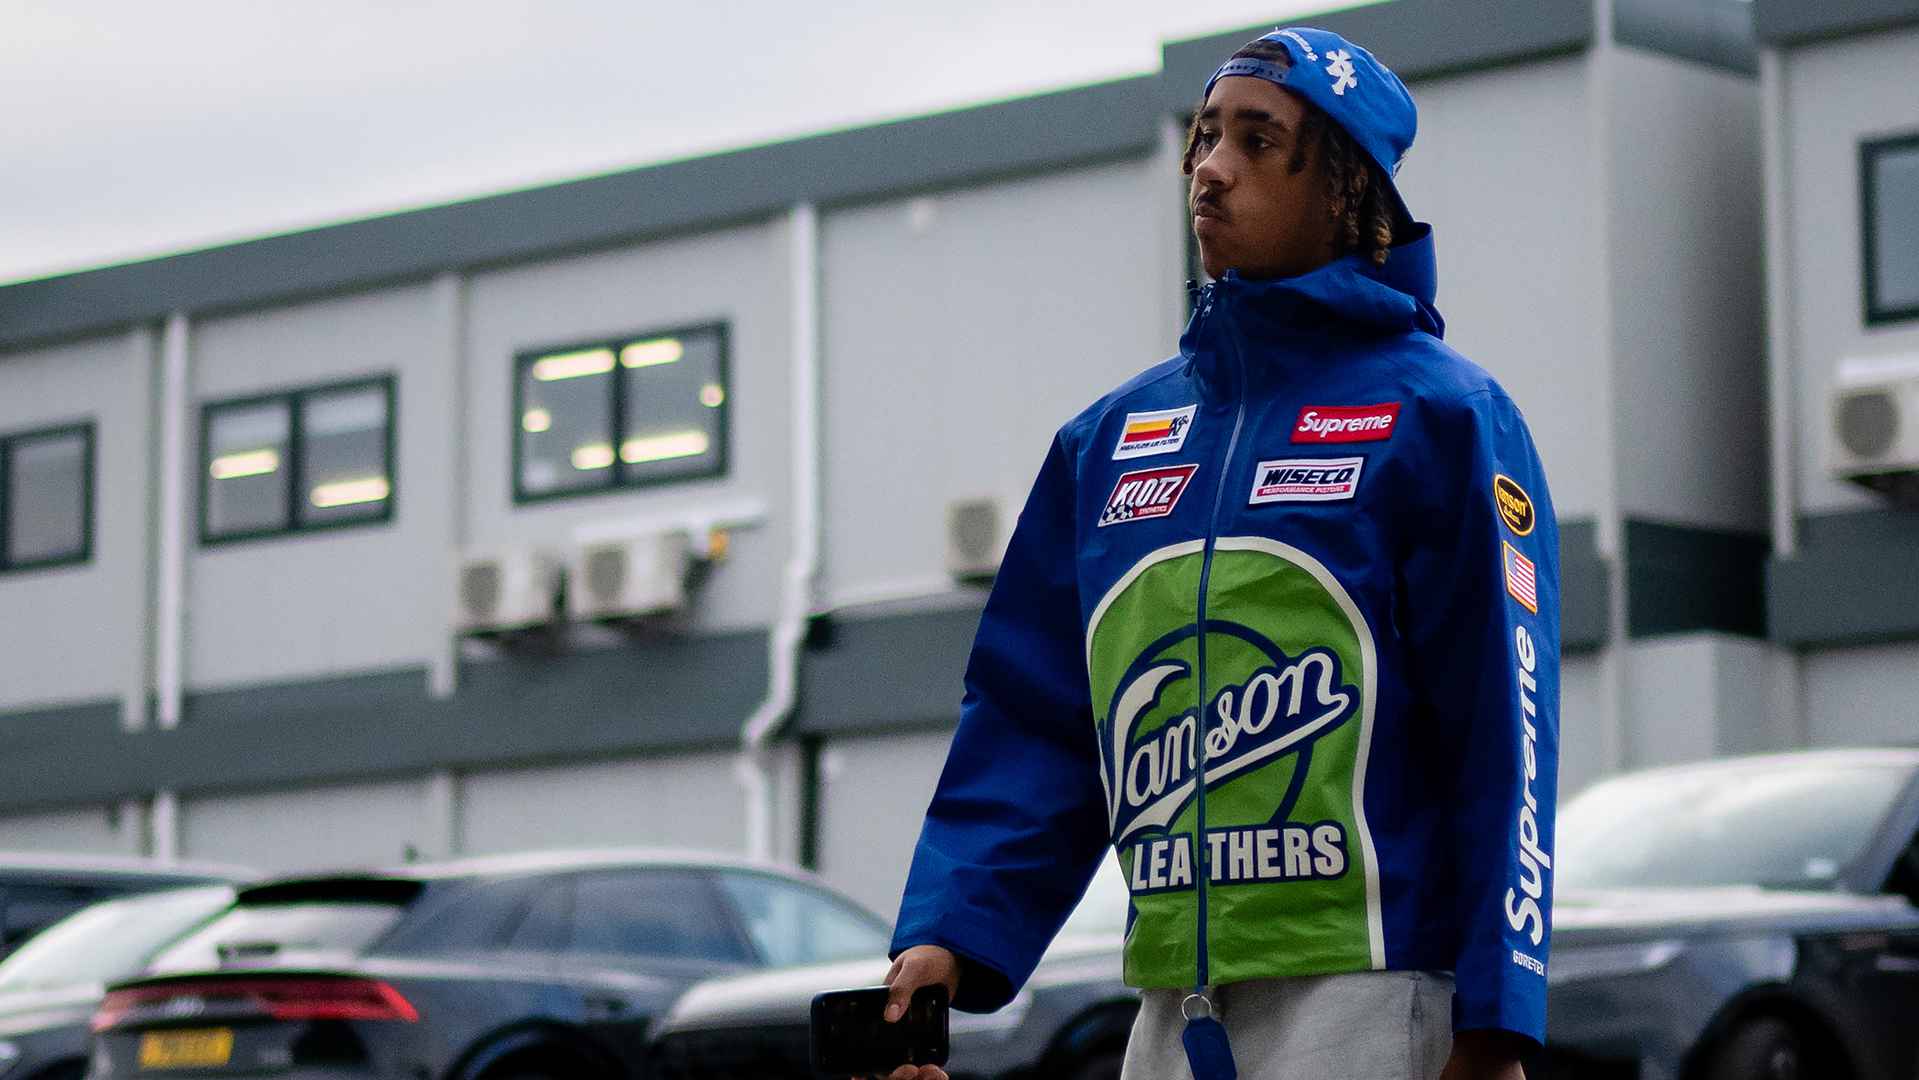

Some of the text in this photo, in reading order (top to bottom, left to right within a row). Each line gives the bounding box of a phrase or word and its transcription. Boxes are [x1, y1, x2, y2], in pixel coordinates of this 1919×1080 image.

[1298, 411, 1393, 438] Supreme
[1111, 476, 1184, 508] KLOTZ
[1261, 467, 1355, 486] WISECO
[1505, 625, 1551, 946] Supreme
[1131, 824, 1345, 891] LEATHERS
